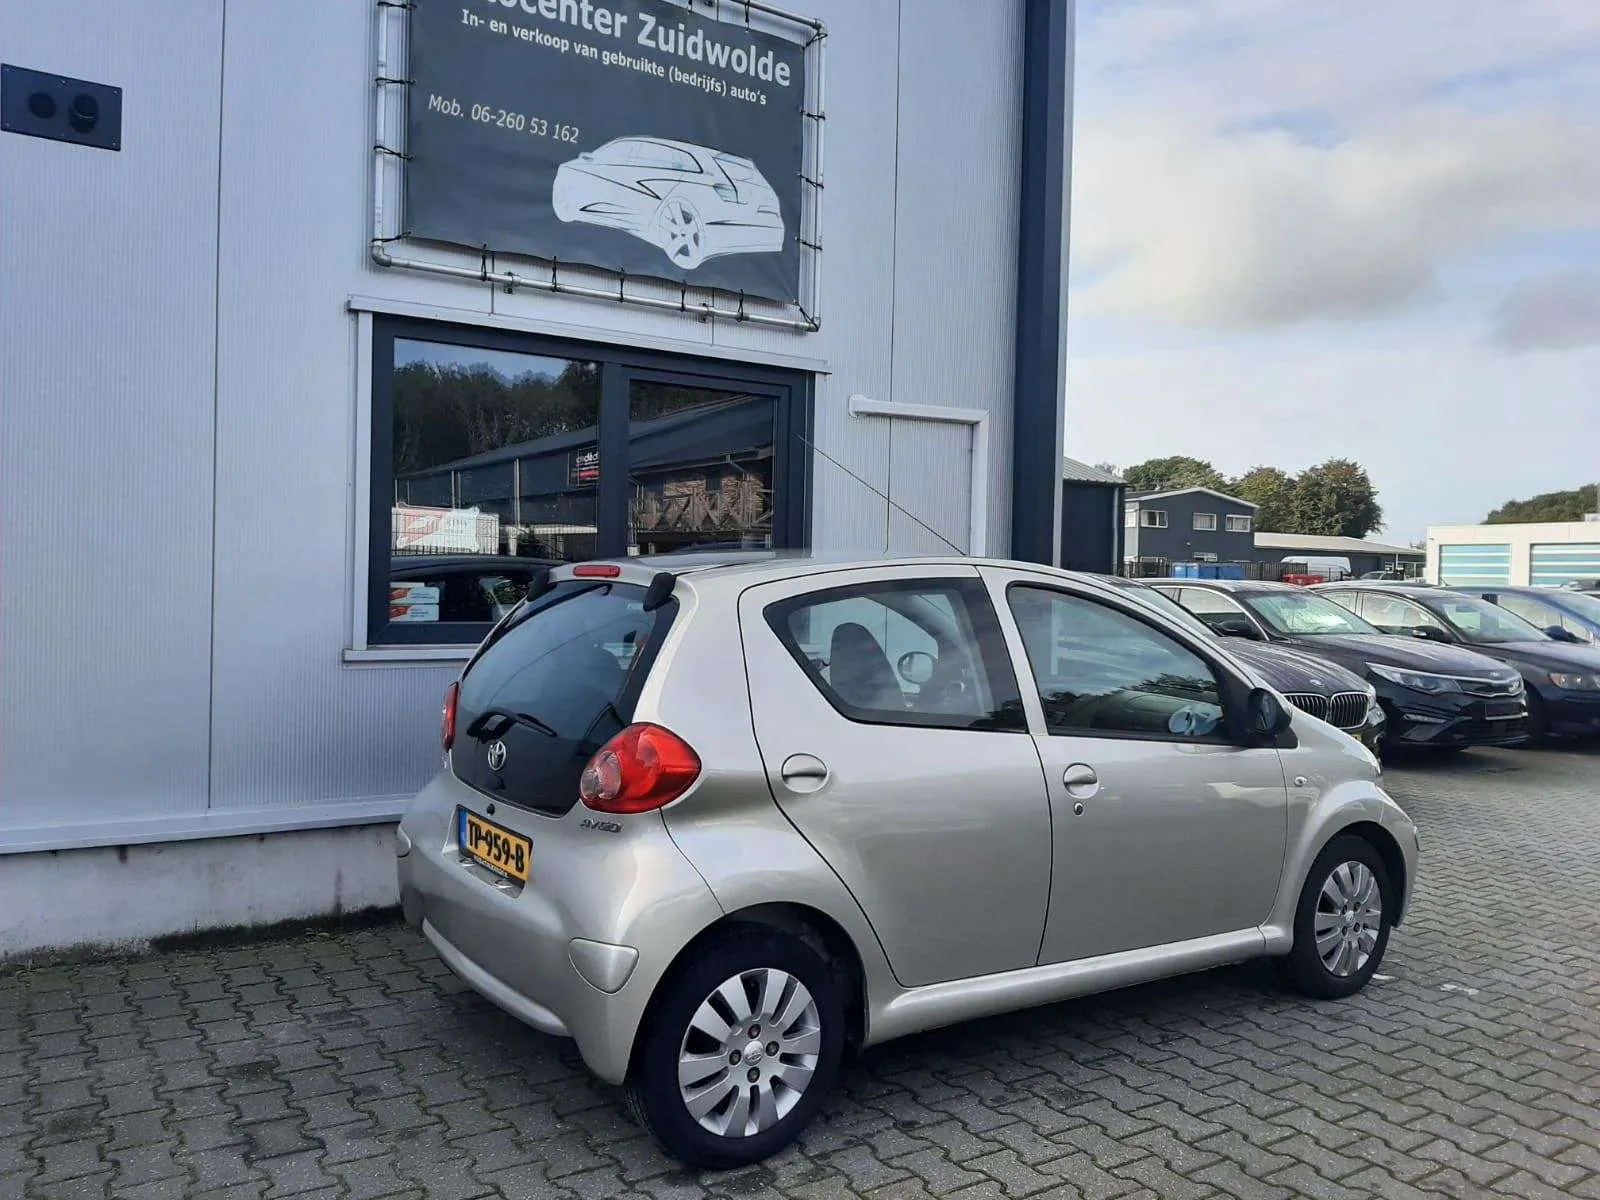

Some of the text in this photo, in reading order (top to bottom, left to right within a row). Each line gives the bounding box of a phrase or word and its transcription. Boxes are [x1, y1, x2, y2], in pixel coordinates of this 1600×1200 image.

[462, 8, 485, 27] In-
[490, 20, 508, 34] en
[512, 25, 570, 53] verkoop
[574, 41, 598, 59] van
[602, 49, 665, 78] gebruikte
[668, 65, 727, 97] (bedrijfs)
[637, 12, 791, 86] Zuidwolde
[428, 93, 579, 144] Mob. 06-260 53 162
[468, 819, 525, 873] TP-959-B
